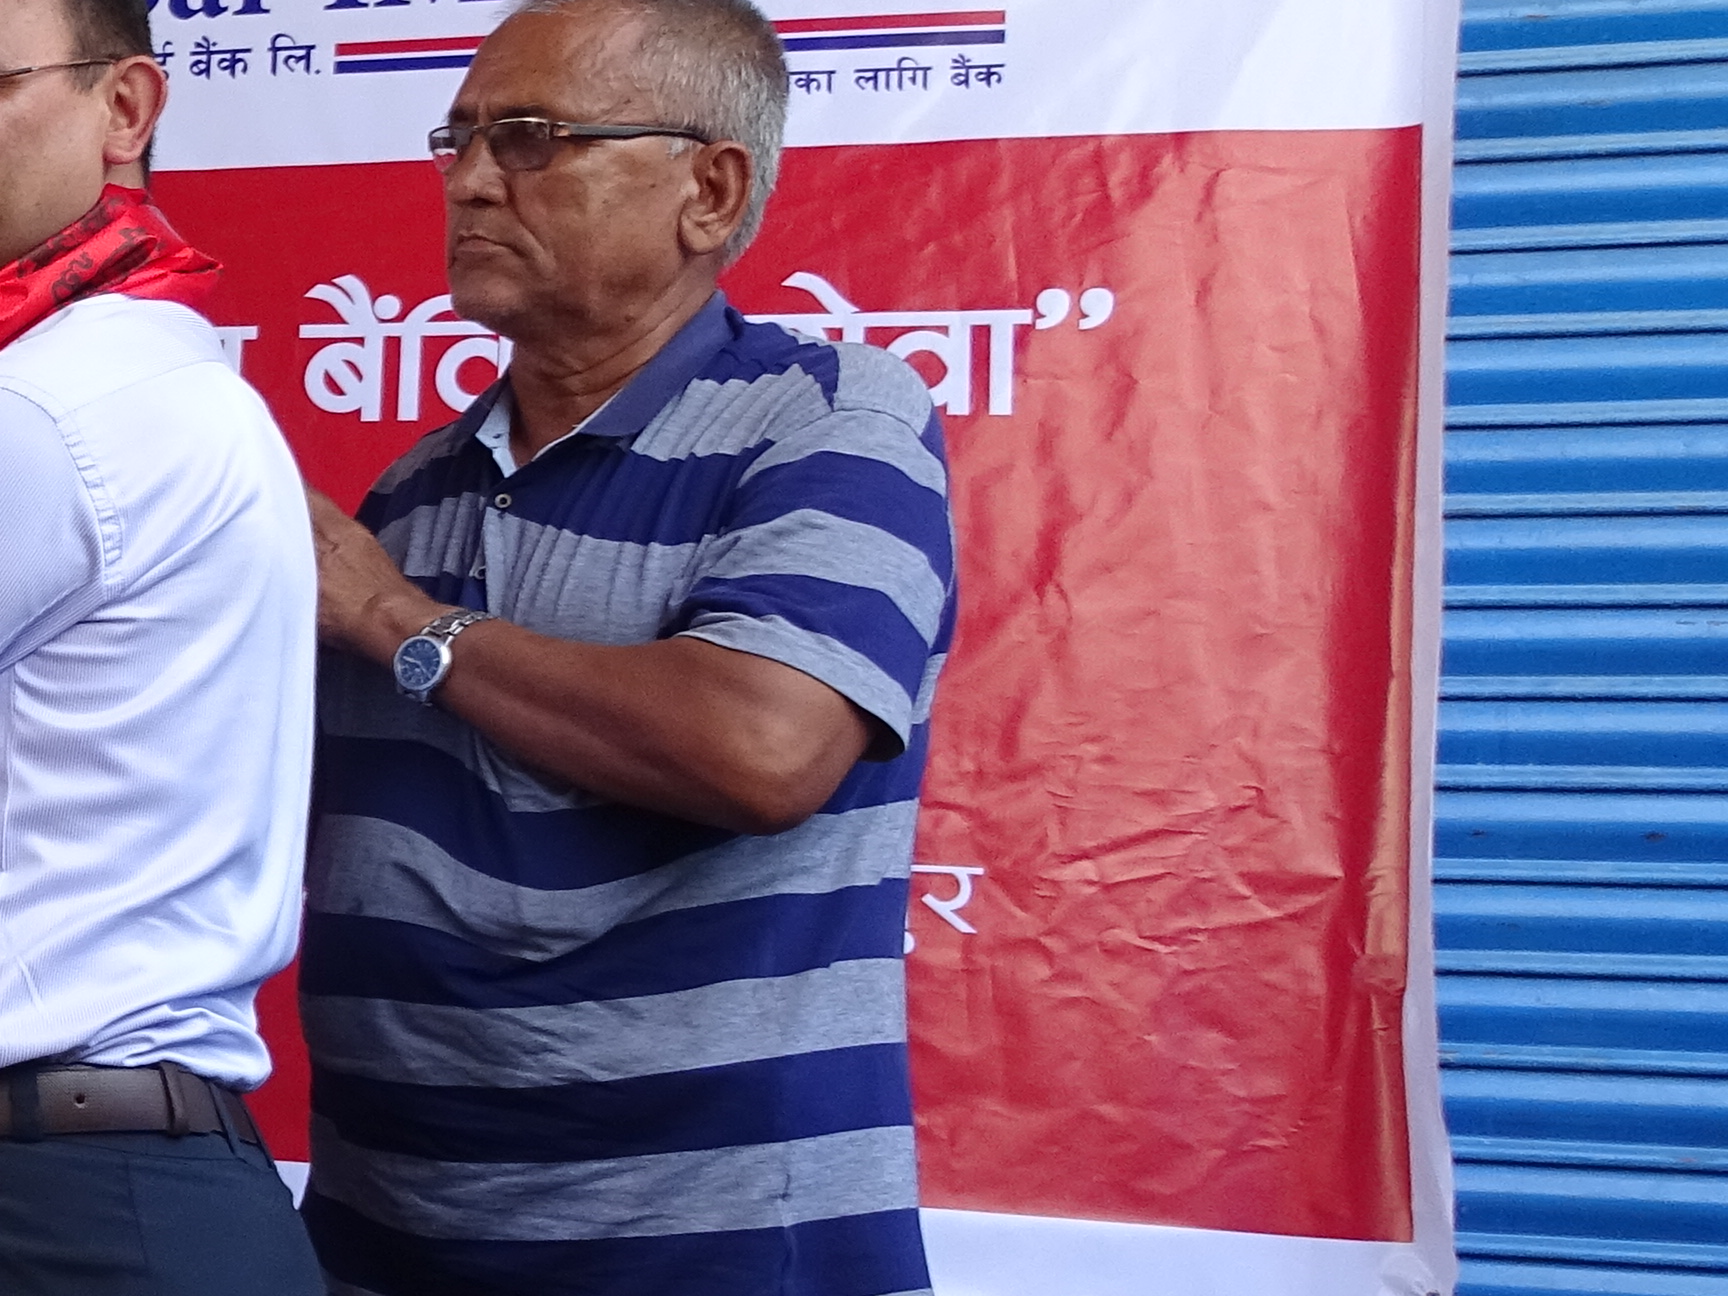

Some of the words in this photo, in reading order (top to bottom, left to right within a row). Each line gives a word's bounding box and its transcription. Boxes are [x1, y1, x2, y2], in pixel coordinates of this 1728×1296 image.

[189, 35, 253, 80] बैंक
[267, 33, 322, 76] लि.
[853, 56, 933, 92] लागि
[950, 54, 1006, 89] बैंक
